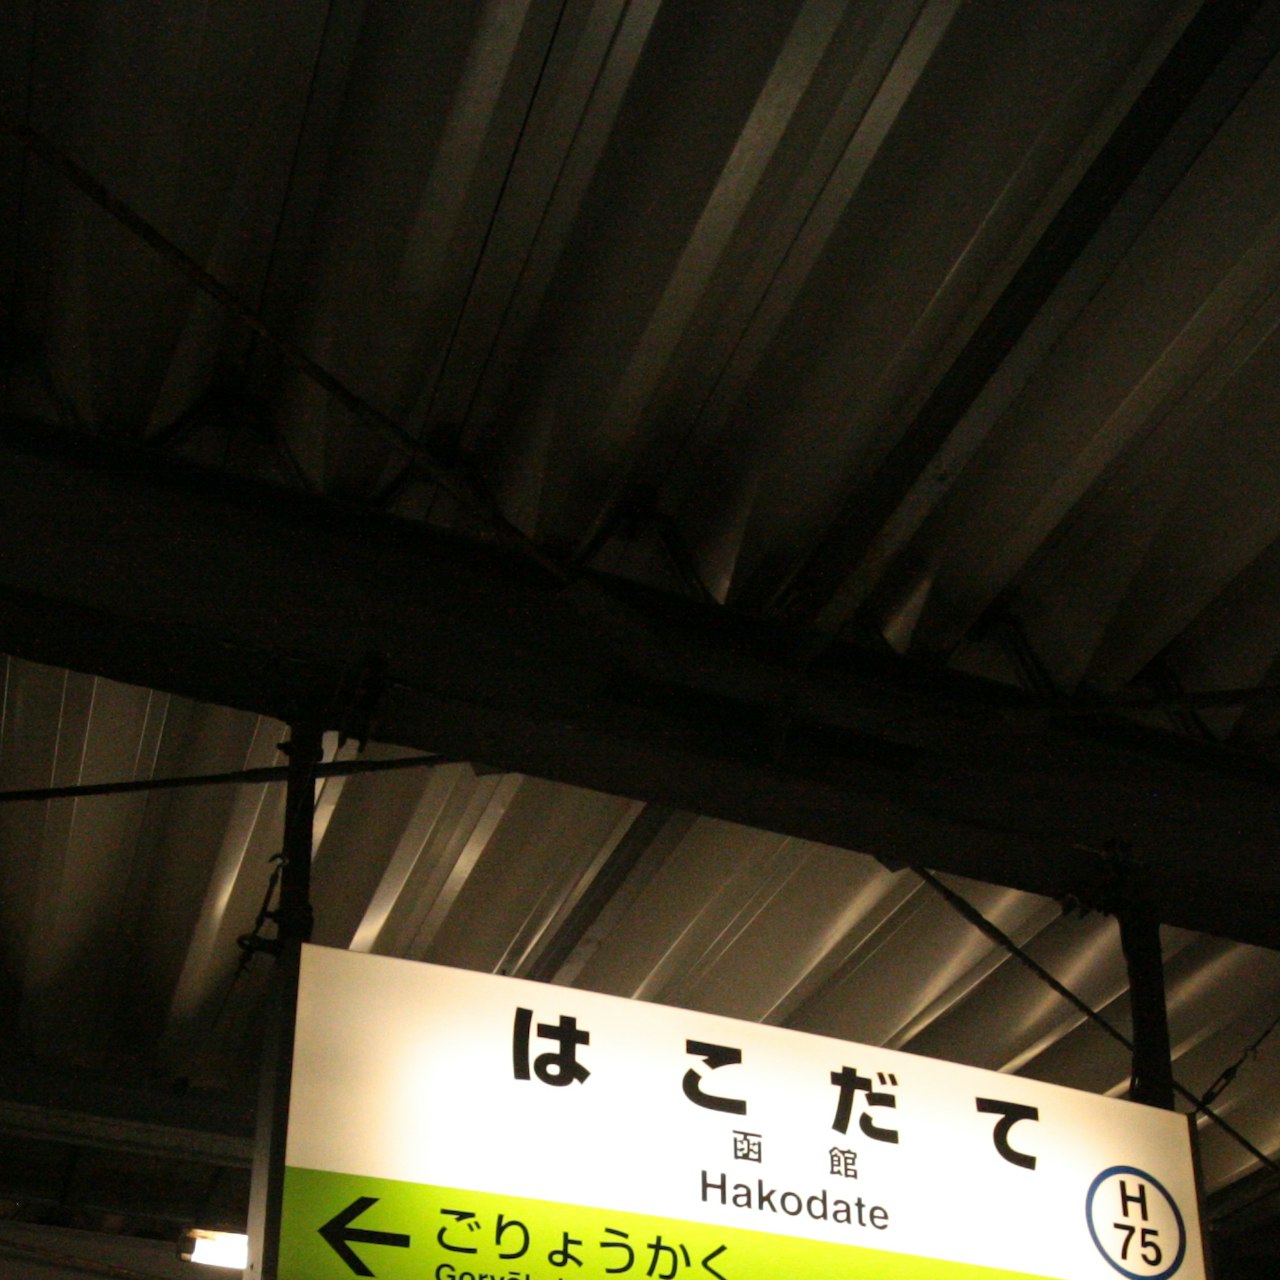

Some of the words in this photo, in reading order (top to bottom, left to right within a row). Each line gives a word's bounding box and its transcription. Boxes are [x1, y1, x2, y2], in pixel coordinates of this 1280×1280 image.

[512, 1006, 1041, 1171] はこだて
[731, 1130, 860, 1182] 函館
[700, 1169, 891, 1231] Hakodate
[1118, 1180, 1147, 1222] H
[1112, 1223, 1164, 1267] 75
